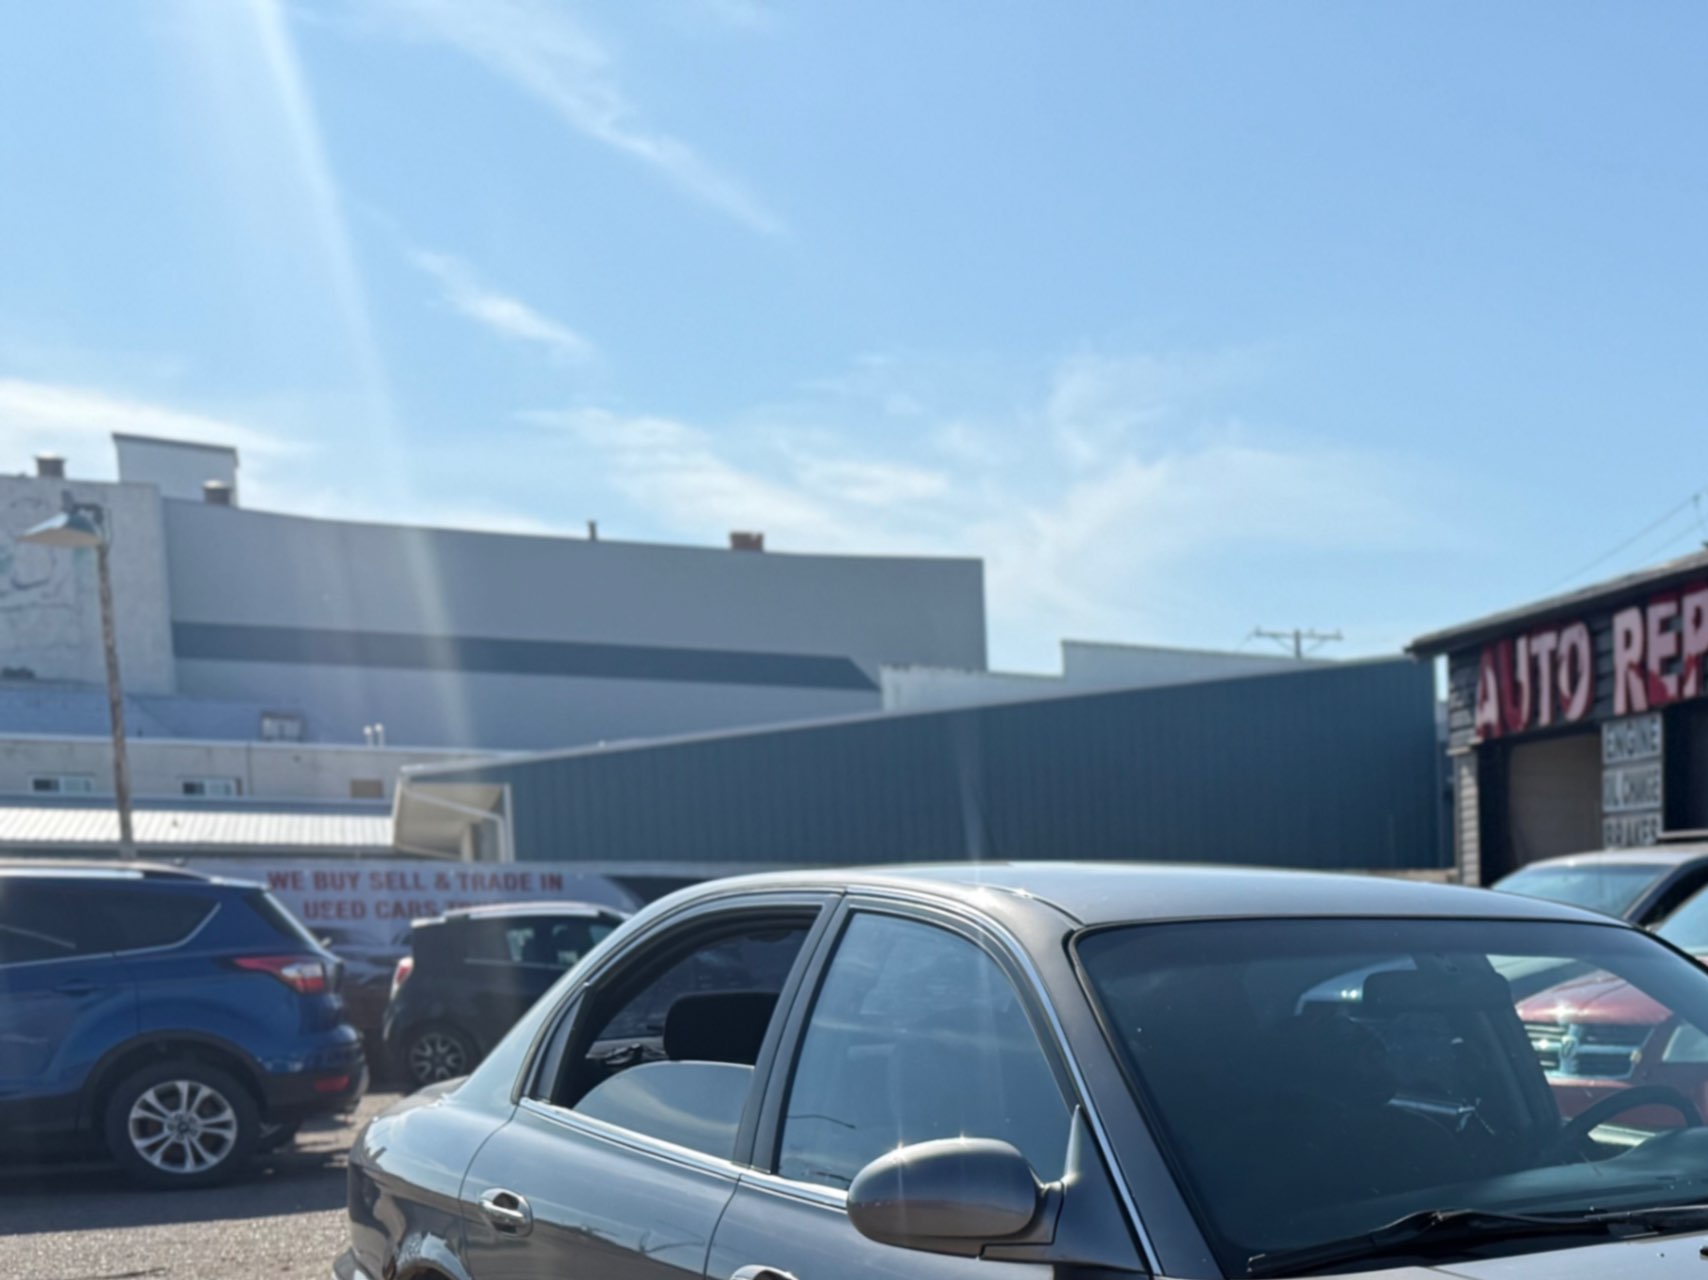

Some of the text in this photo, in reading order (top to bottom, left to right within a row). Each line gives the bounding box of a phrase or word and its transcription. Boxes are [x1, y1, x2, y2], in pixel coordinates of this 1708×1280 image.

[1474, 620, 1596, 738] AUTO
[1606, 717, 1658, 759] ENGINE
[267, 871, 563, 892] WE BUY SELL & TRADE IN
[303, 901, 366, 920] USED
[375, 901, 436, 920] CARS
